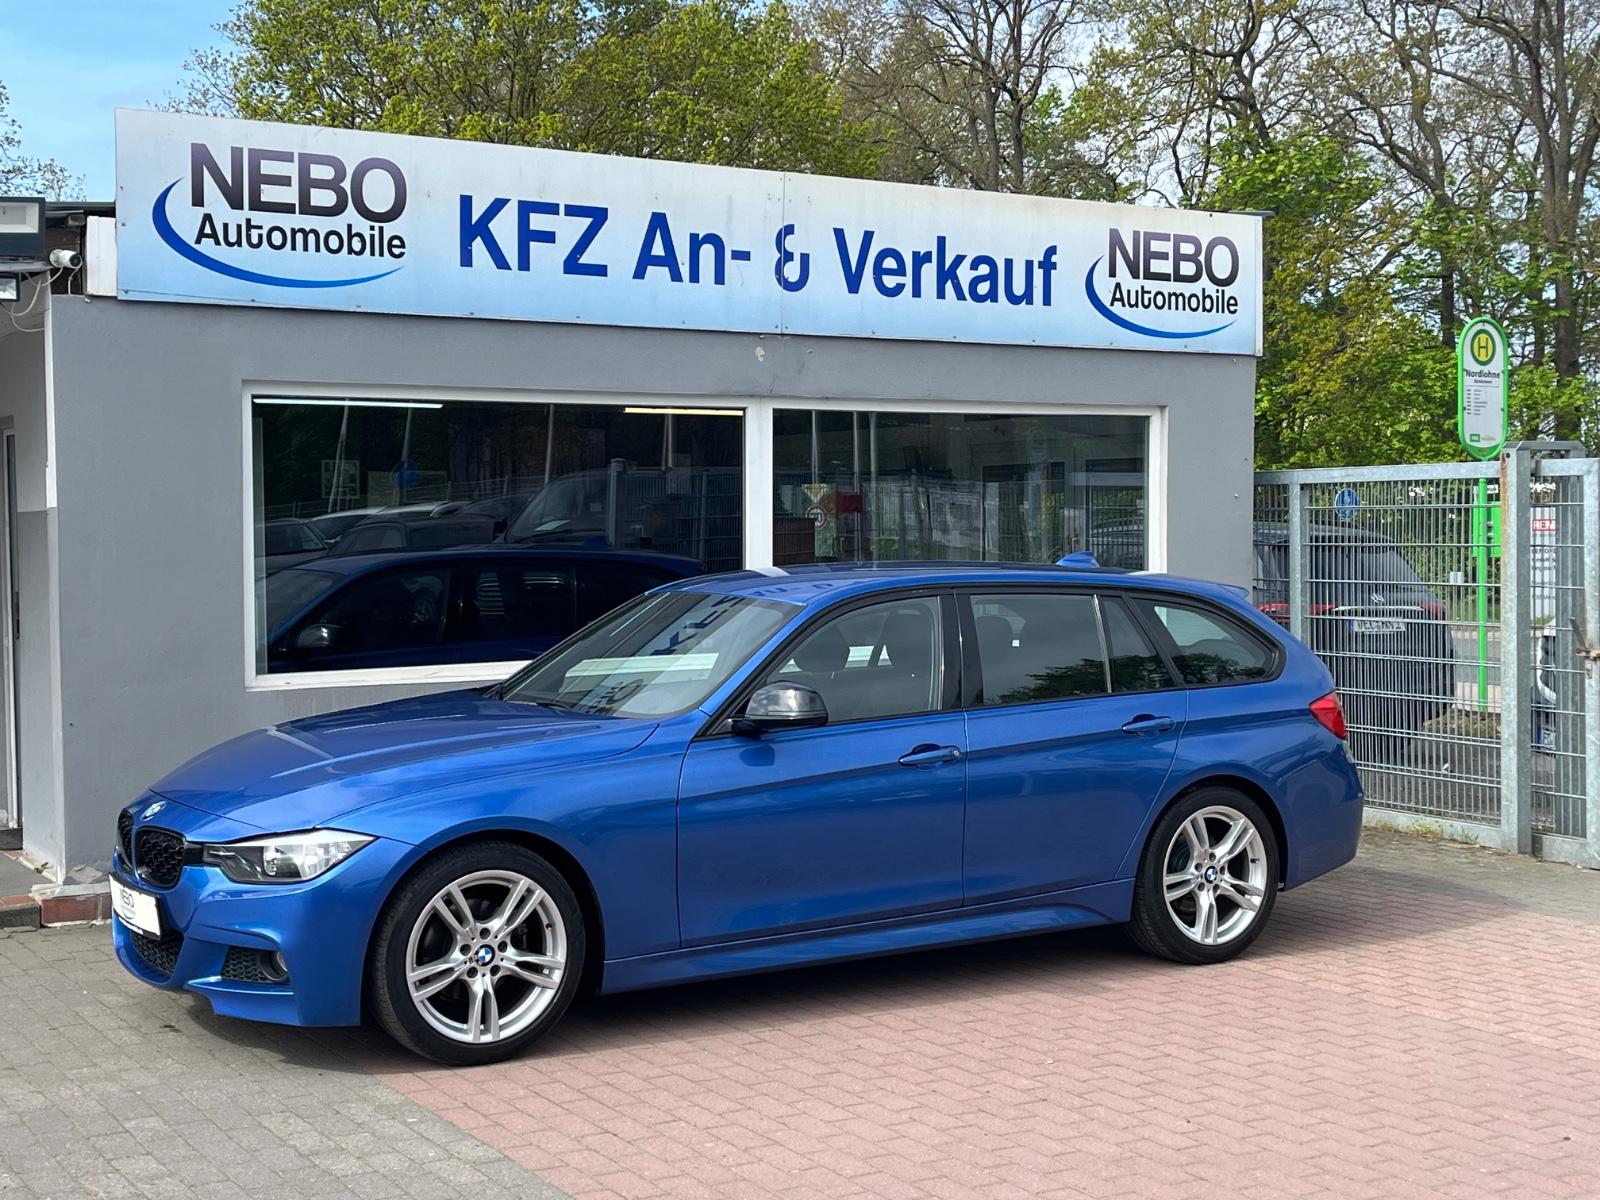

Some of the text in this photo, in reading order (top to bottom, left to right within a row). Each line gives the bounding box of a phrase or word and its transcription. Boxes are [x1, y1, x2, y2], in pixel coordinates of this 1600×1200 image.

[191, 142, 407, 223] NEBO
[195, 212, 407, 259] Automobile
[459, 195, 1059, 307] KFZ An- & Verkauf
[1108, 228, 1240, 287] NEBO
[1109, 281, 1240, 315] Automobile
[1477, 337, 1489, 358] H
[1465, 369, 1501, 380] Nordlohne
